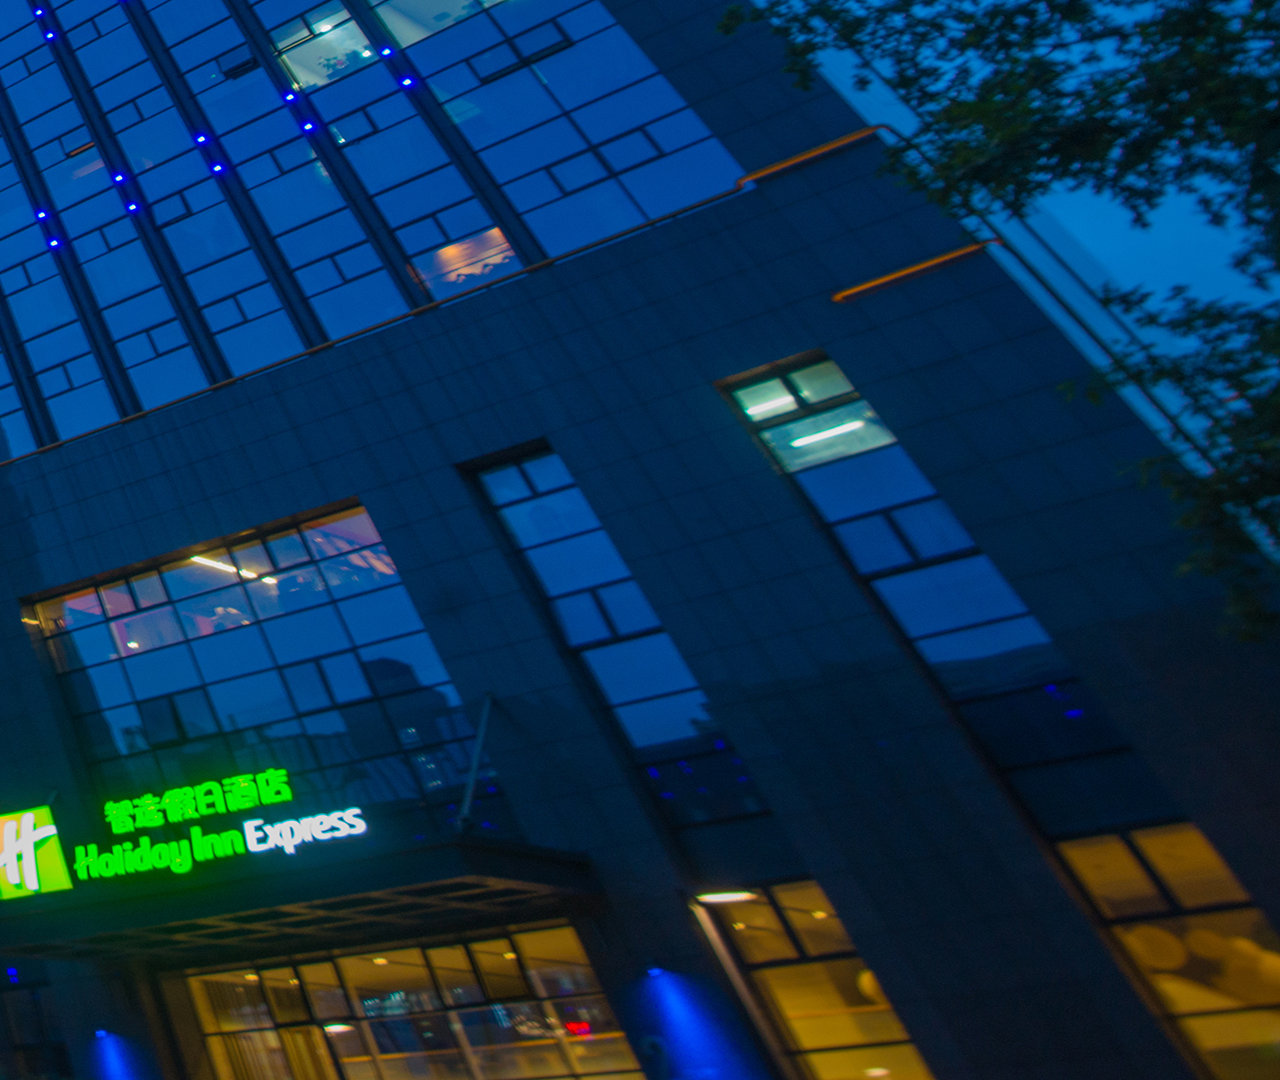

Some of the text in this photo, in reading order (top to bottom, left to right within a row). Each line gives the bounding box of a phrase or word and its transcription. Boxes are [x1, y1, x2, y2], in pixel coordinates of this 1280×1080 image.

[73, 807, 368, 880] Holiday Inn Express
